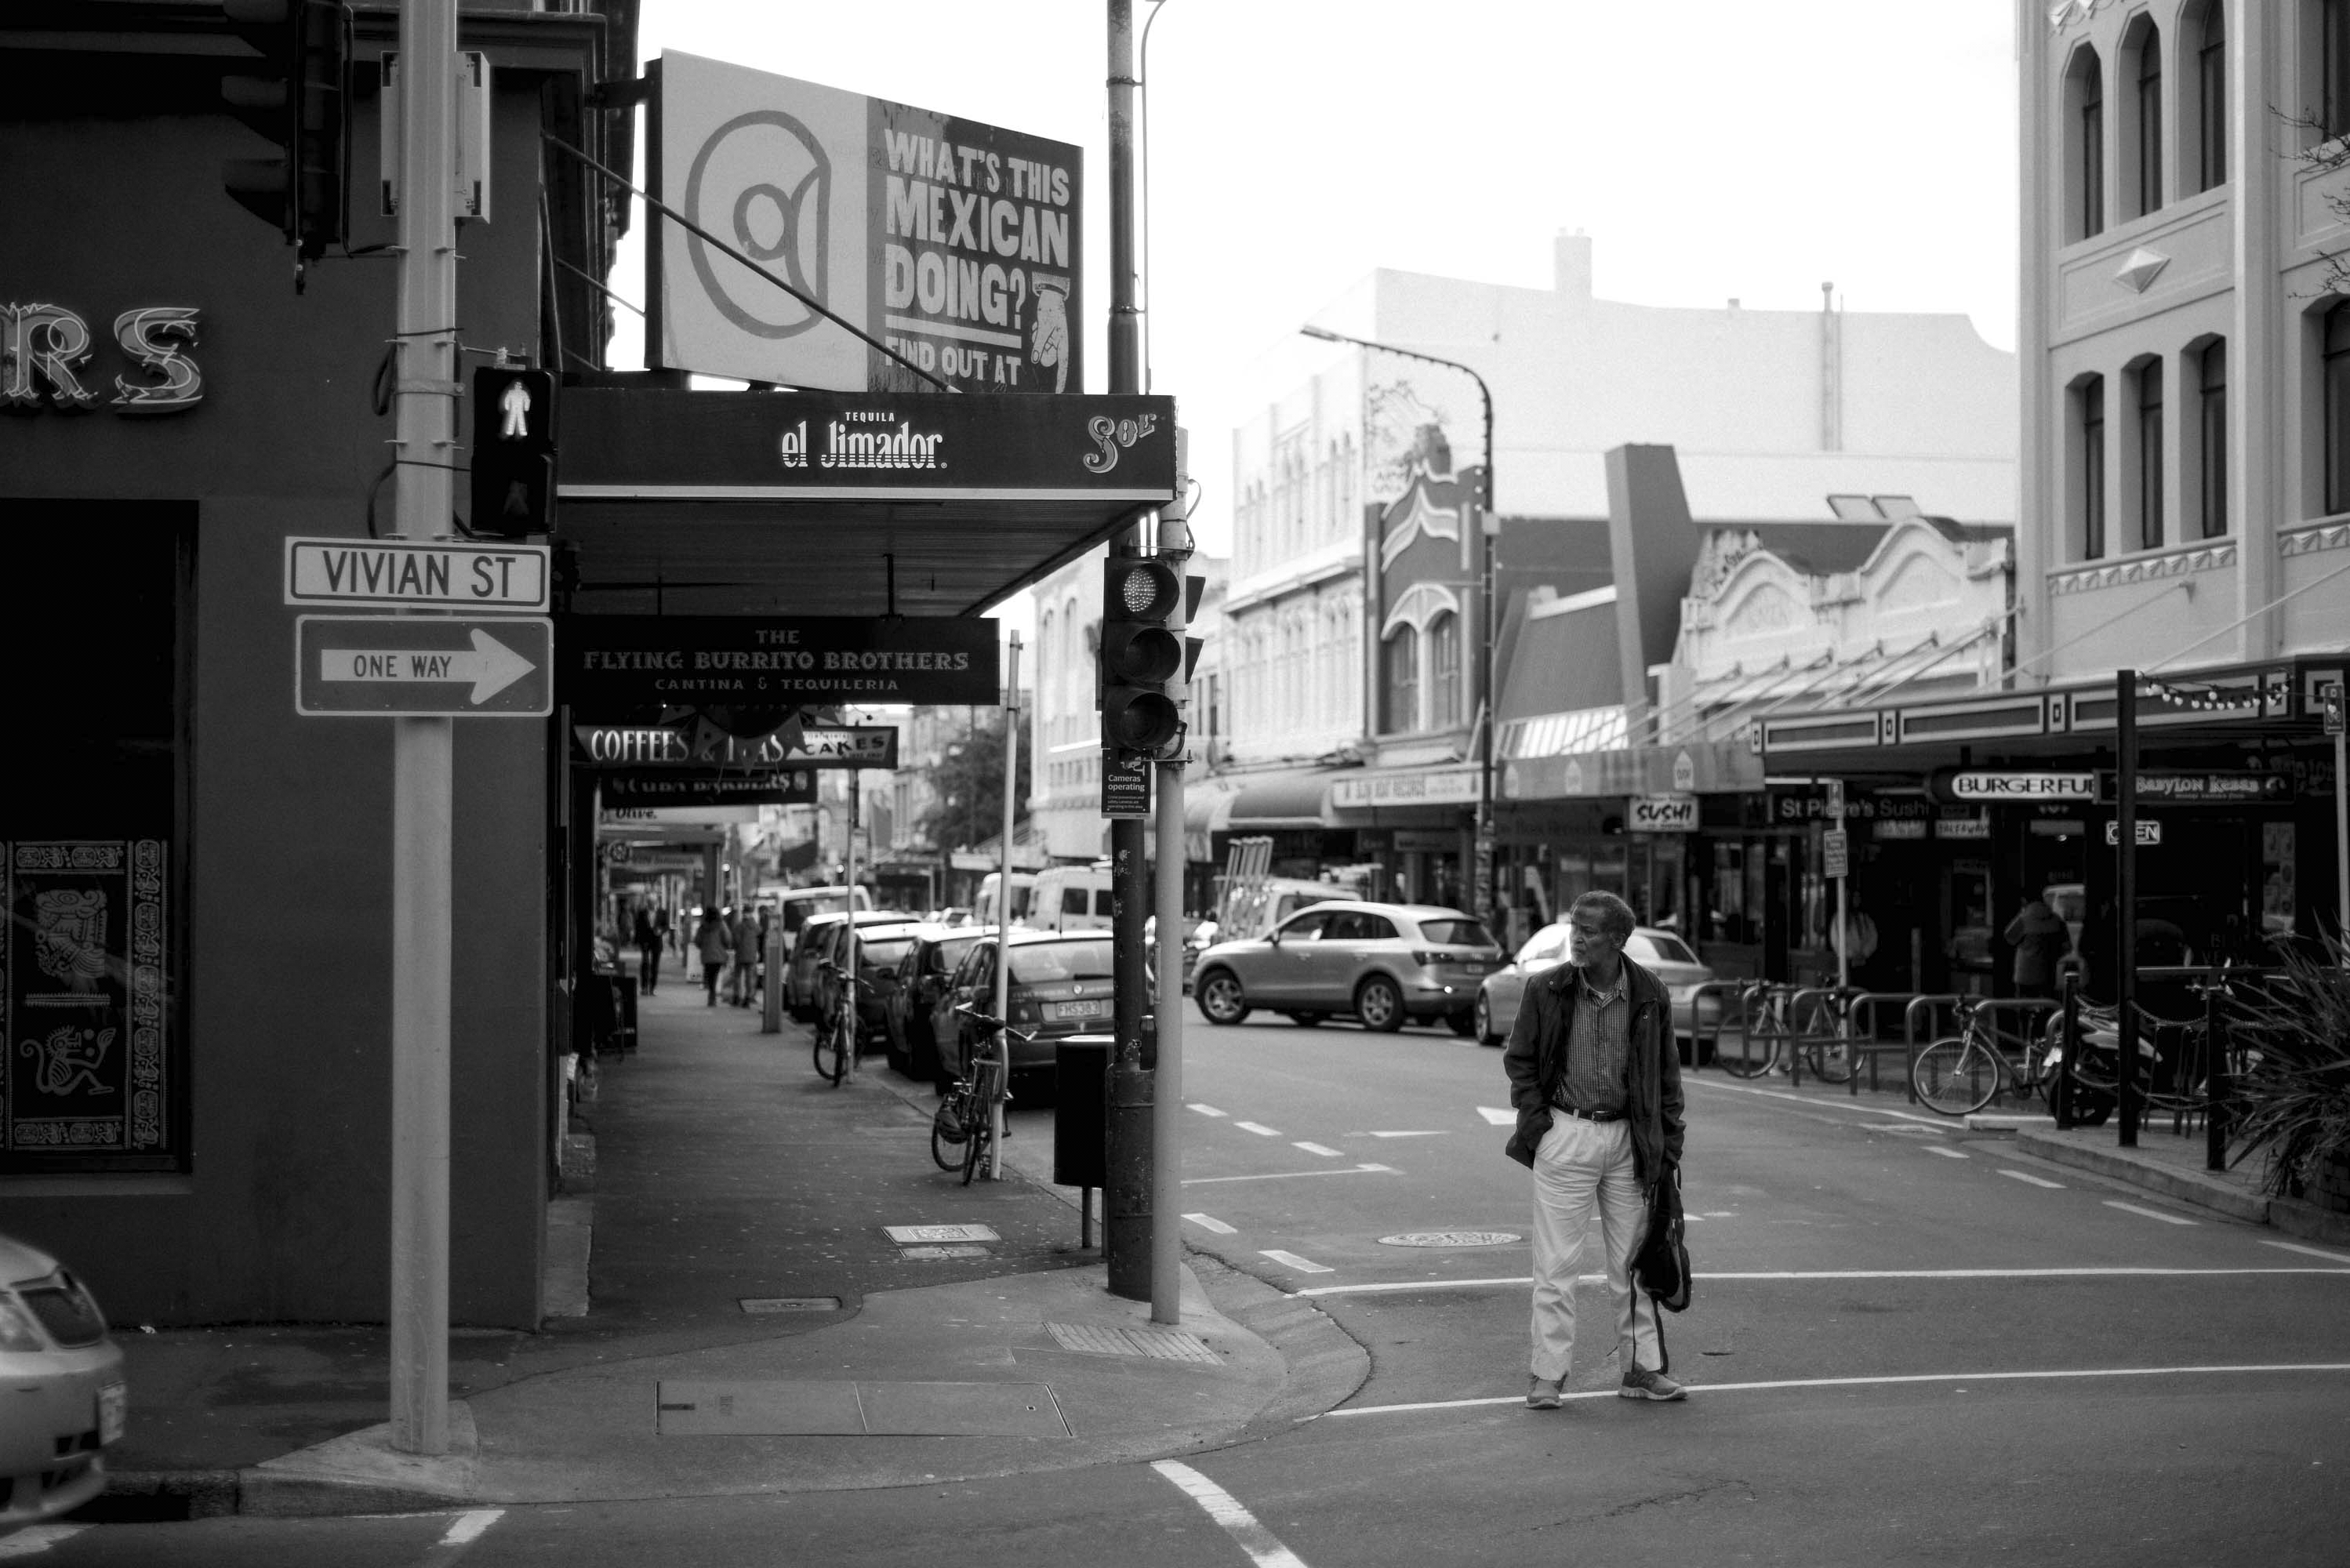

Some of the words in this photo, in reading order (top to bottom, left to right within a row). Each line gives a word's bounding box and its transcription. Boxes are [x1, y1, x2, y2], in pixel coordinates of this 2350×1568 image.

[884, 129, 1000, 194] WHAT'S
[1008, 157, 1070, 207] THIS
[886, 175, 1069, 268] MEXICAN
[885, 243, 1026, 329] DOING?
[885, 336, 935, 372] FIND
[942, 347, 988, 381] OUT
[995, 354, 1022, 386] AT
[845, 412, 895, 423] TEQUILA
[782, 422, 808, 468] el
[322, 550, 450, 597] VIVIAN
[470, 555, 516, 598] ST
[755, 629, 801, 644] THE
[354, 655, 398, 678] ONE
[411, 655, 452, 679] WAY
[583, 651, 685, 670] FLYING
[695, 651, 815, 670] BURRITO
[823, 651, 969, 671] BROTHERS
[655, 677, 744, 691] CANTINA
[780, 677, 899, 691] TEQUILERIA
[590, 729, 690, 763] COFFEES
[1108, 774, 1141, 782] Cameras
[1108, 783, 1145, 792] operating
[1636, 804, 1691, 822] SUSHI
[1879, 797, 1930, 818] Sushi
[2108, 826, 2158, 842] OEN
